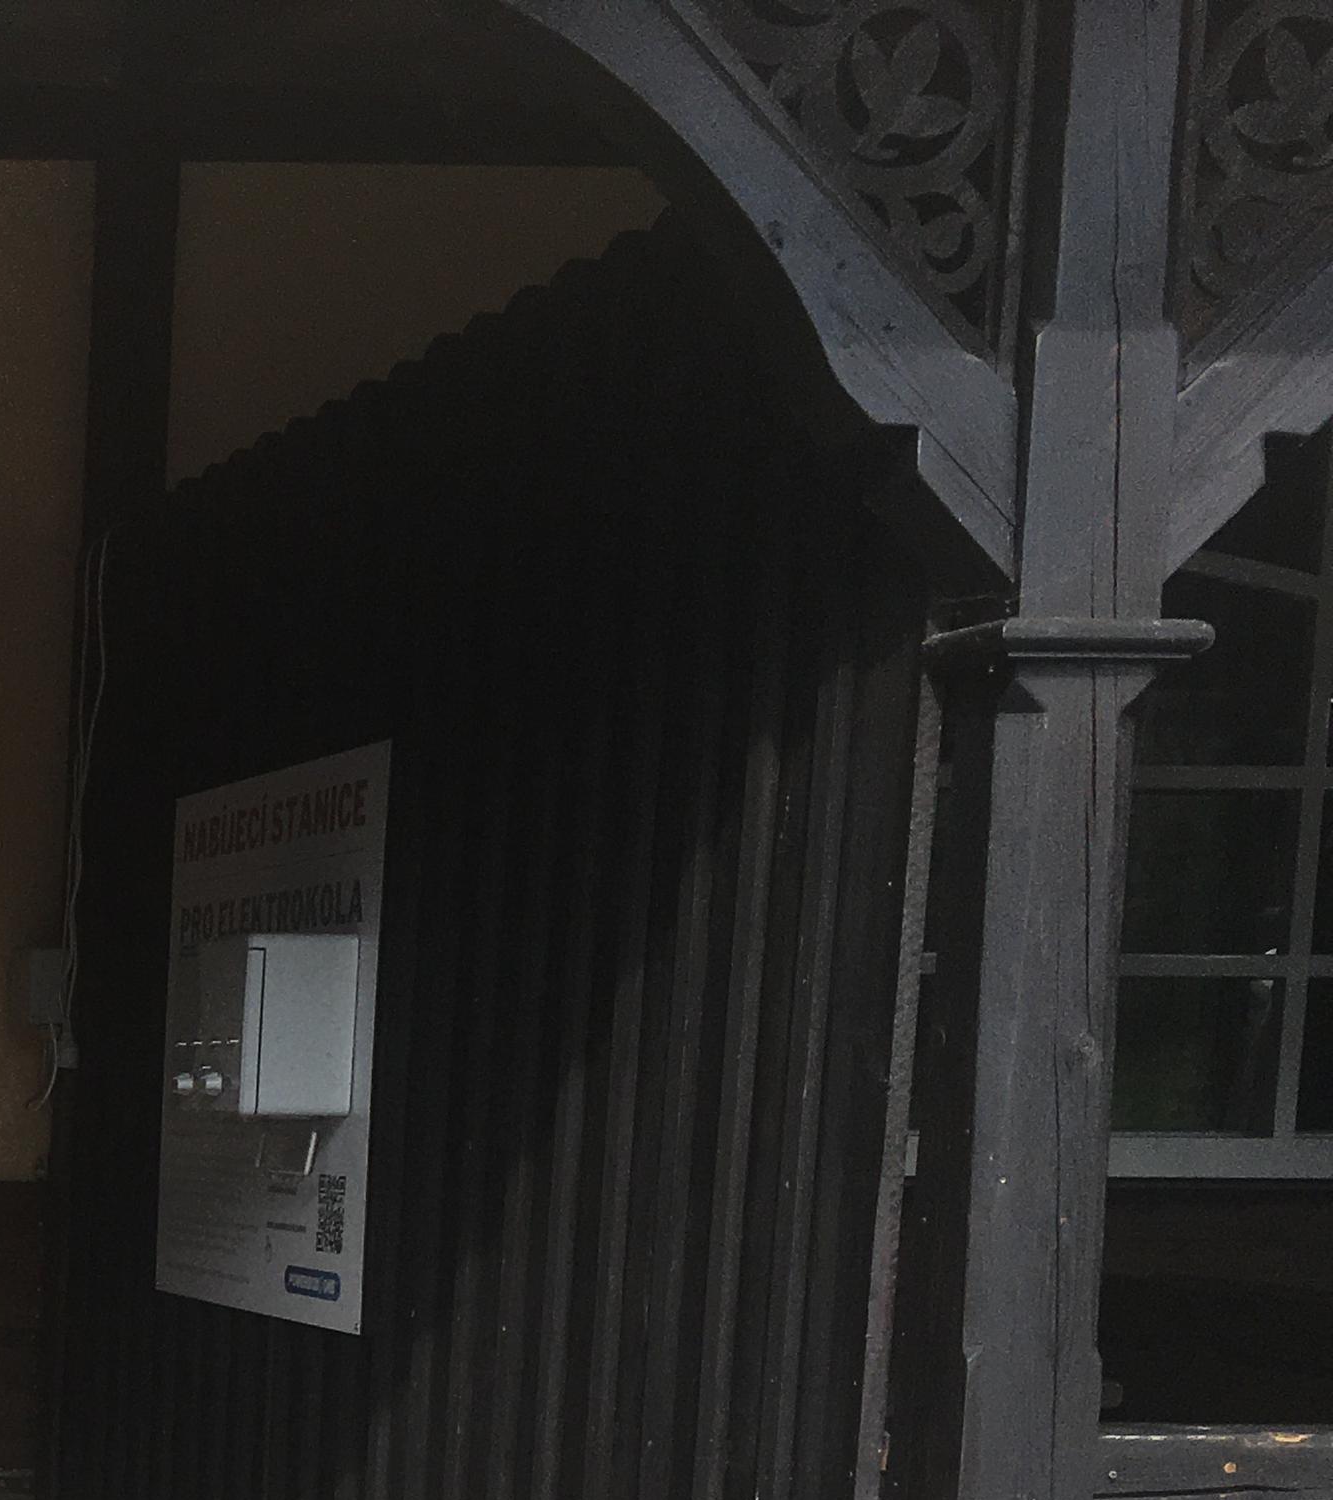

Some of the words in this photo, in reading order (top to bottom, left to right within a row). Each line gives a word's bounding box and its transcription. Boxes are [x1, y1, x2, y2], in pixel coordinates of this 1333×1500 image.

[271, 779, 368, 843] STANICE
[180, 905, 218, 943] PRO
[219, 879, 363, 934] ELEKTROKOLA
